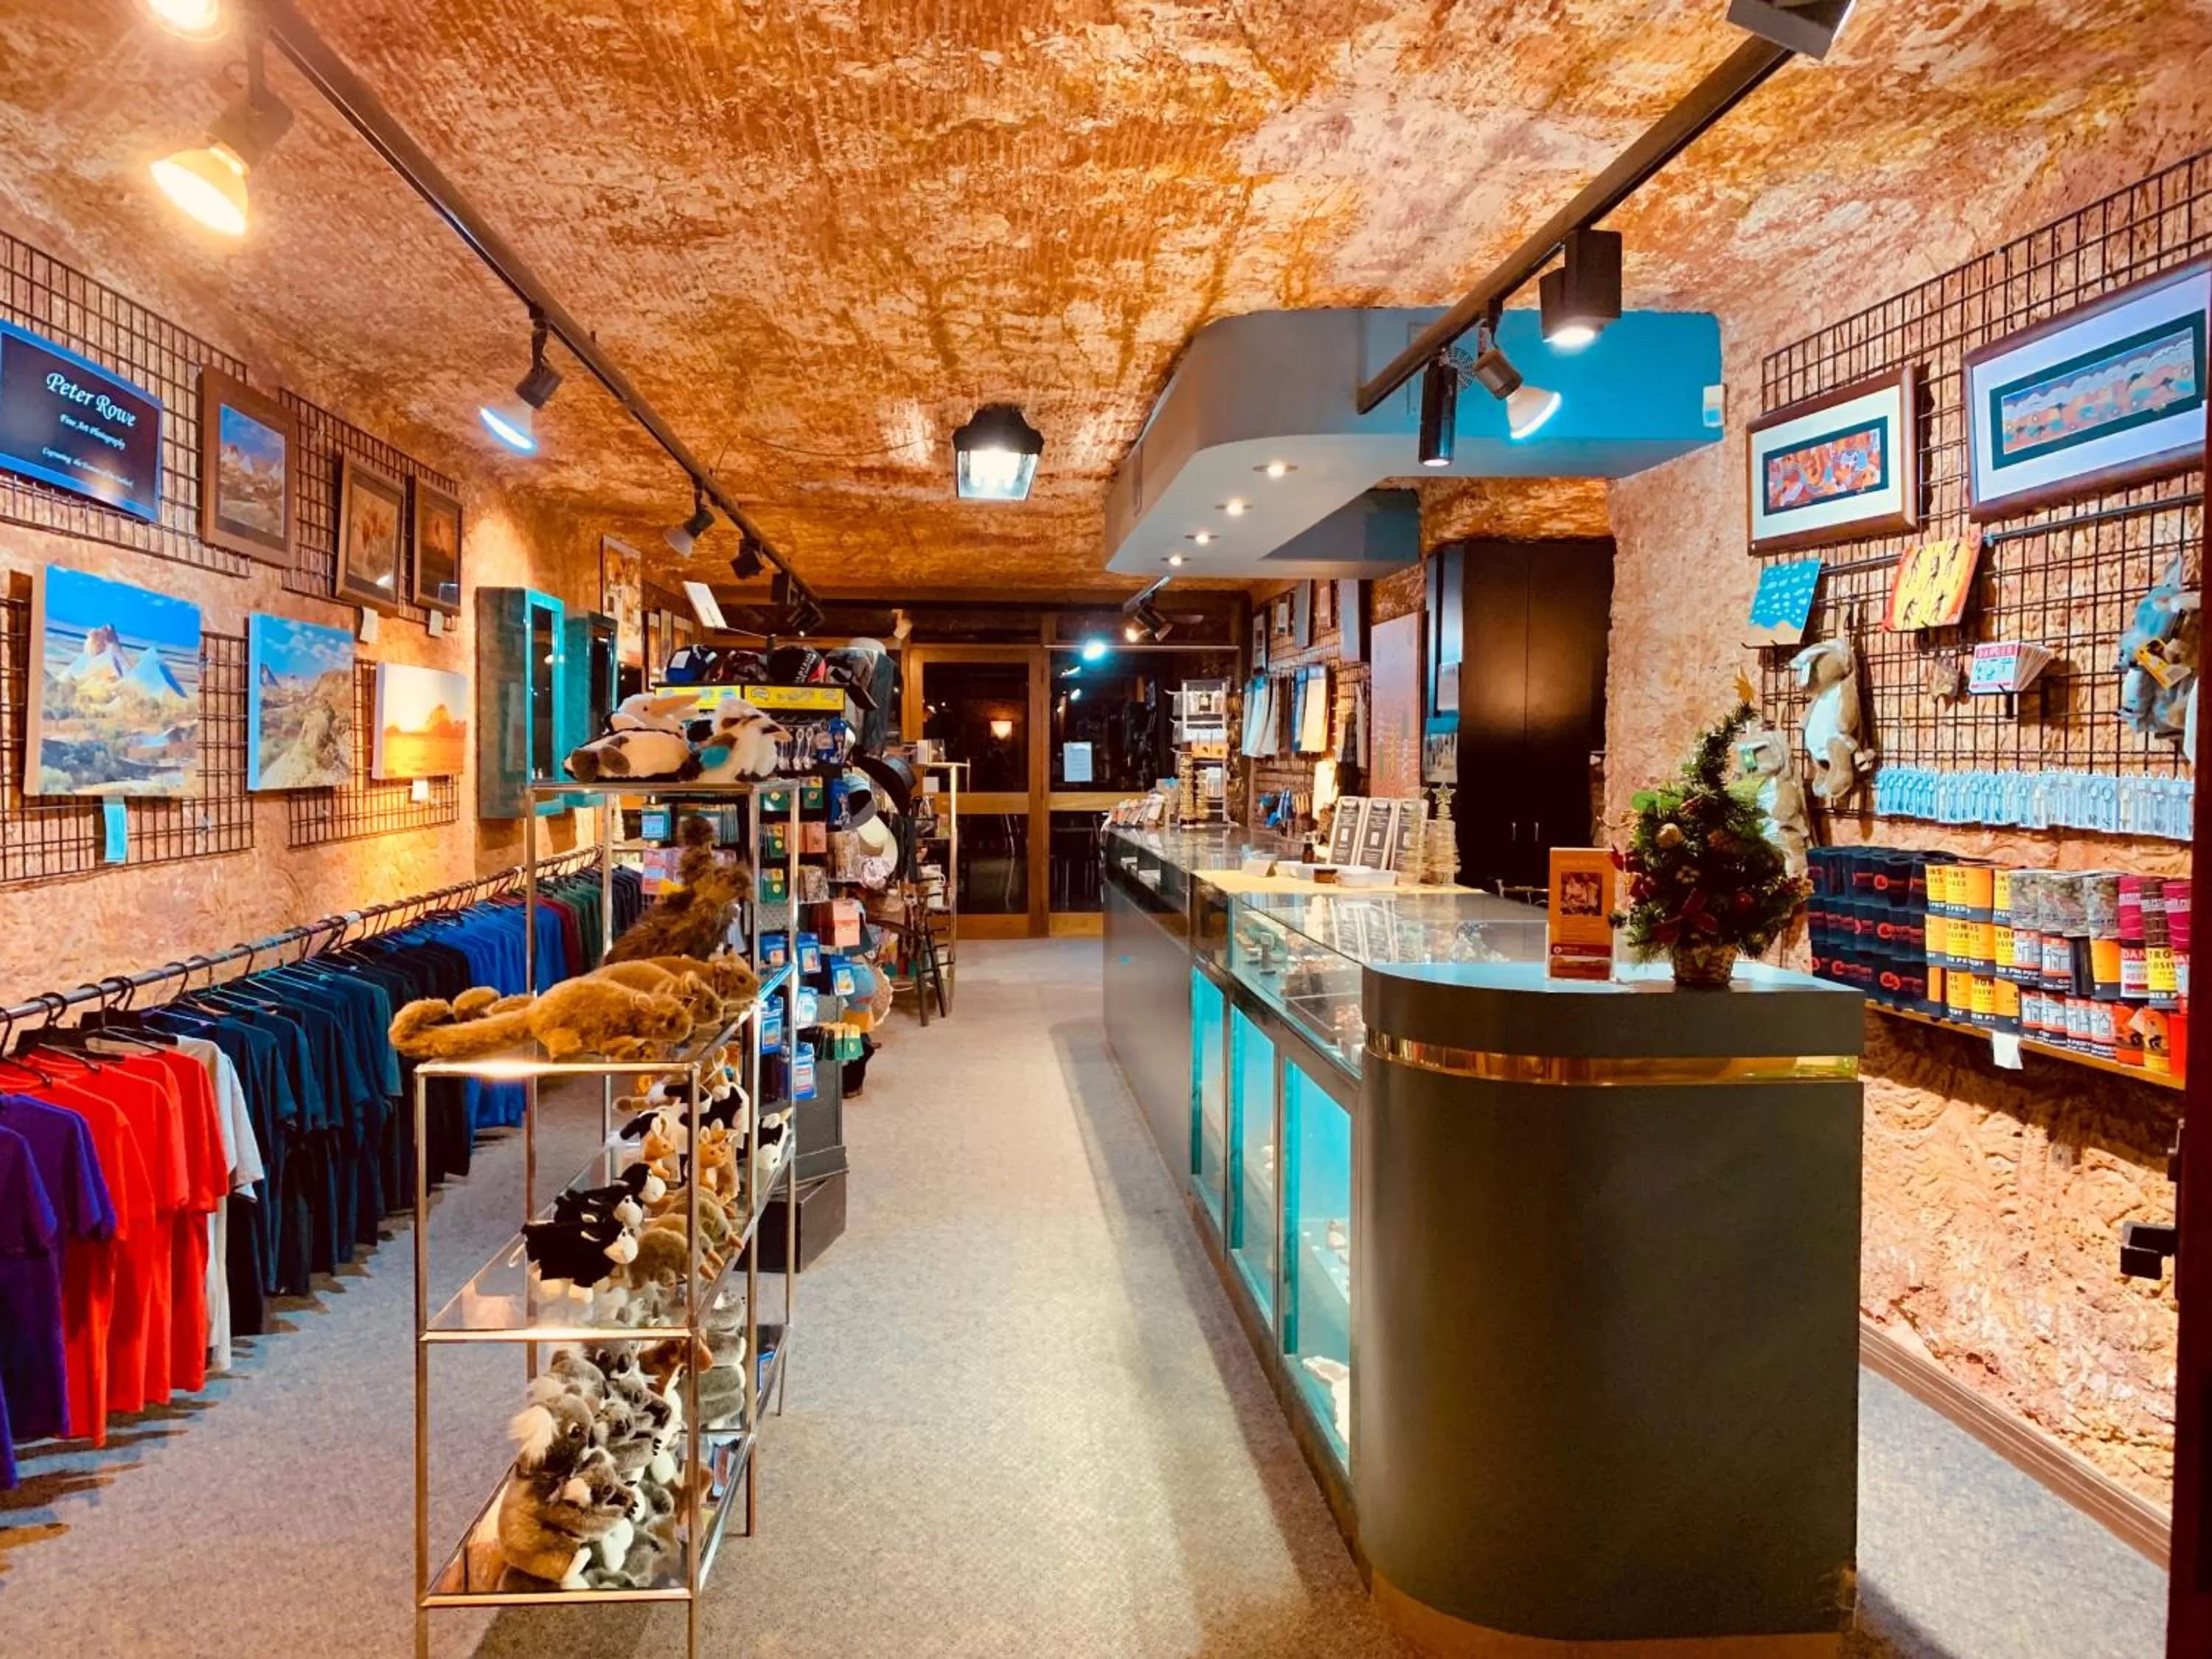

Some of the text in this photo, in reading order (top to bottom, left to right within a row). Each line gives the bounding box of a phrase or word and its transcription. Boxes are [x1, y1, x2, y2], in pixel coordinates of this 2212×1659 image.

[46, 372, 136, 427] Peter Rowe
[1978, 646, 2013, 658] DANGER
